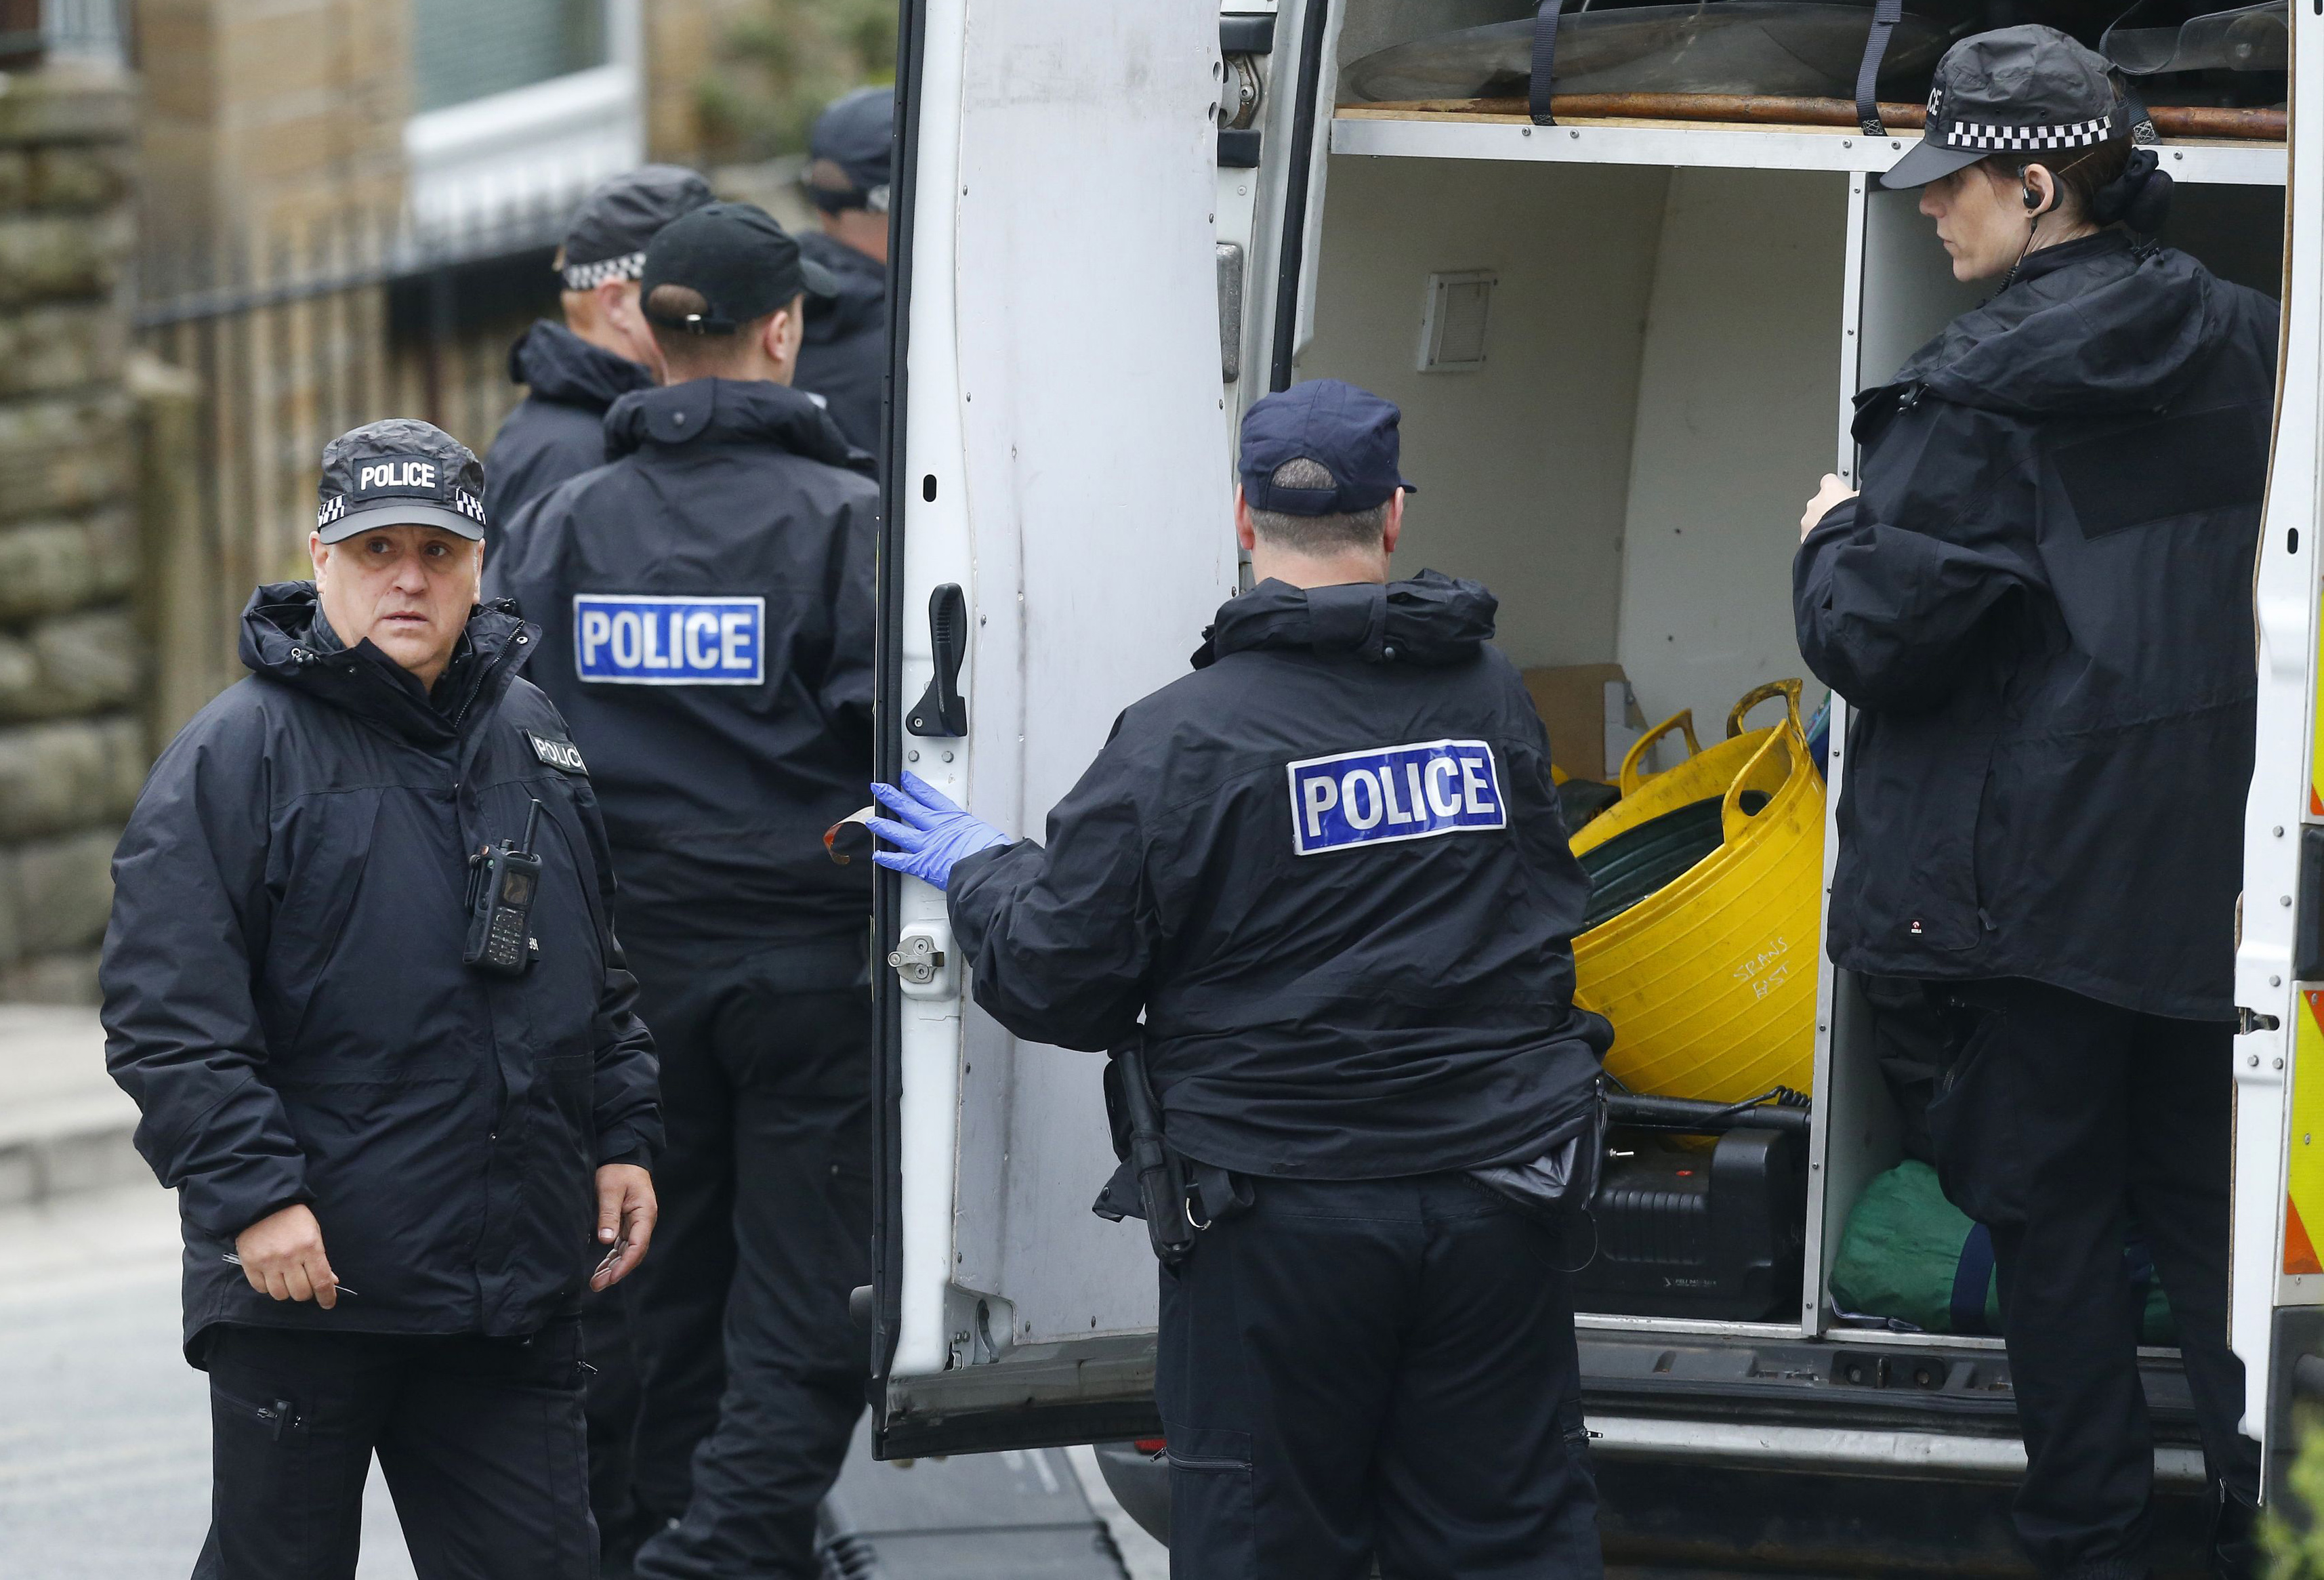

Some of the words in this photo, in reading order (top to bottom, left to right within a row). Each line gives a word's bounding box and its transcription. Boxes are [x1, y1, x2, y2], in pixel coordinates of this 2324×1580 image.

[360, 461, 436, 491] POLICE
[582, 610, 753, 669] POLICE
[534, 739, 585, 770] POLIC
[1303, 756, 1495, 837] POLICE
